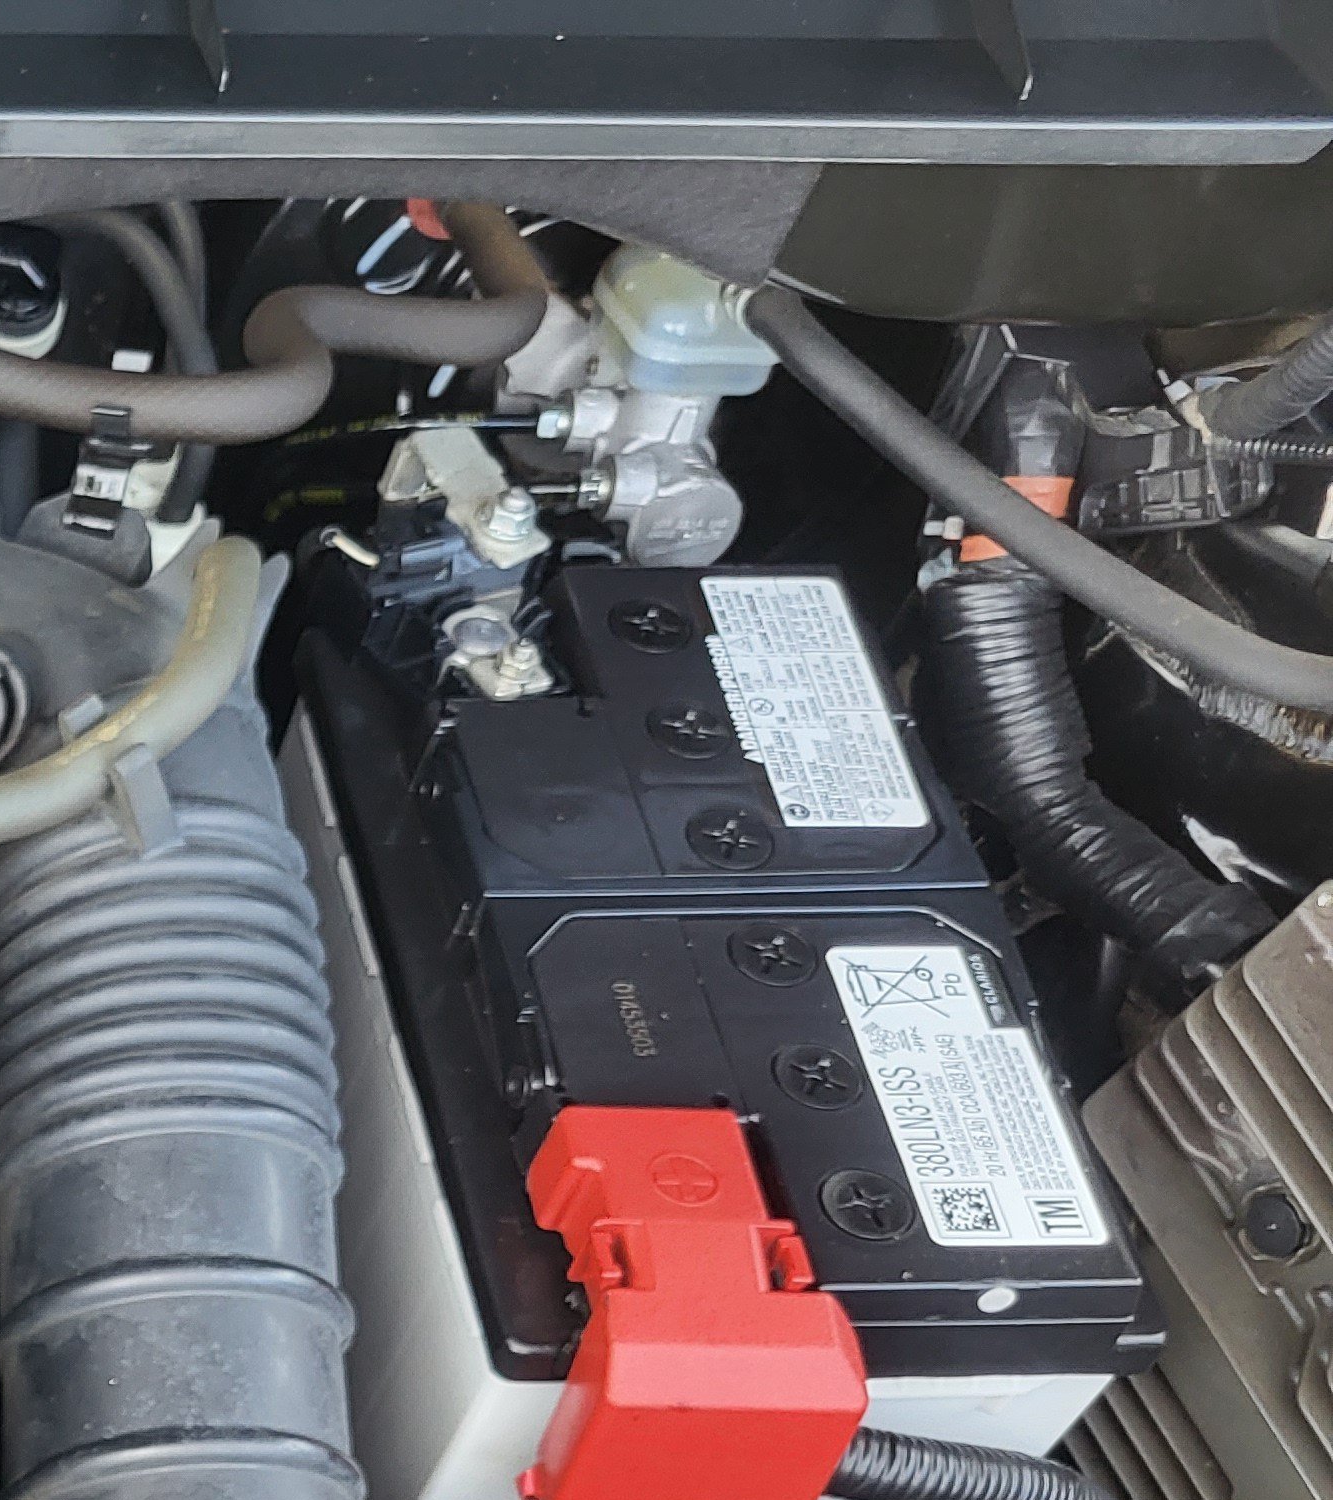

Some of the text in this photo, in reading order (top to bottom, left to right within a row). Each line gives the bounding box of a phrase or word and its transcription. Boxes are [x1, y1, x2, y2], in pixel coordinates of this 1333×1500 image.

[704, 634, 760, 751] DANGER/POISON
[941, 972, 967, 997] Pb
[959, 1095, 982, 1114] CCA
[878, 1066, 954, 1178] 380LN3-ISS
[1032, 1199, 1084, 1233] TM
